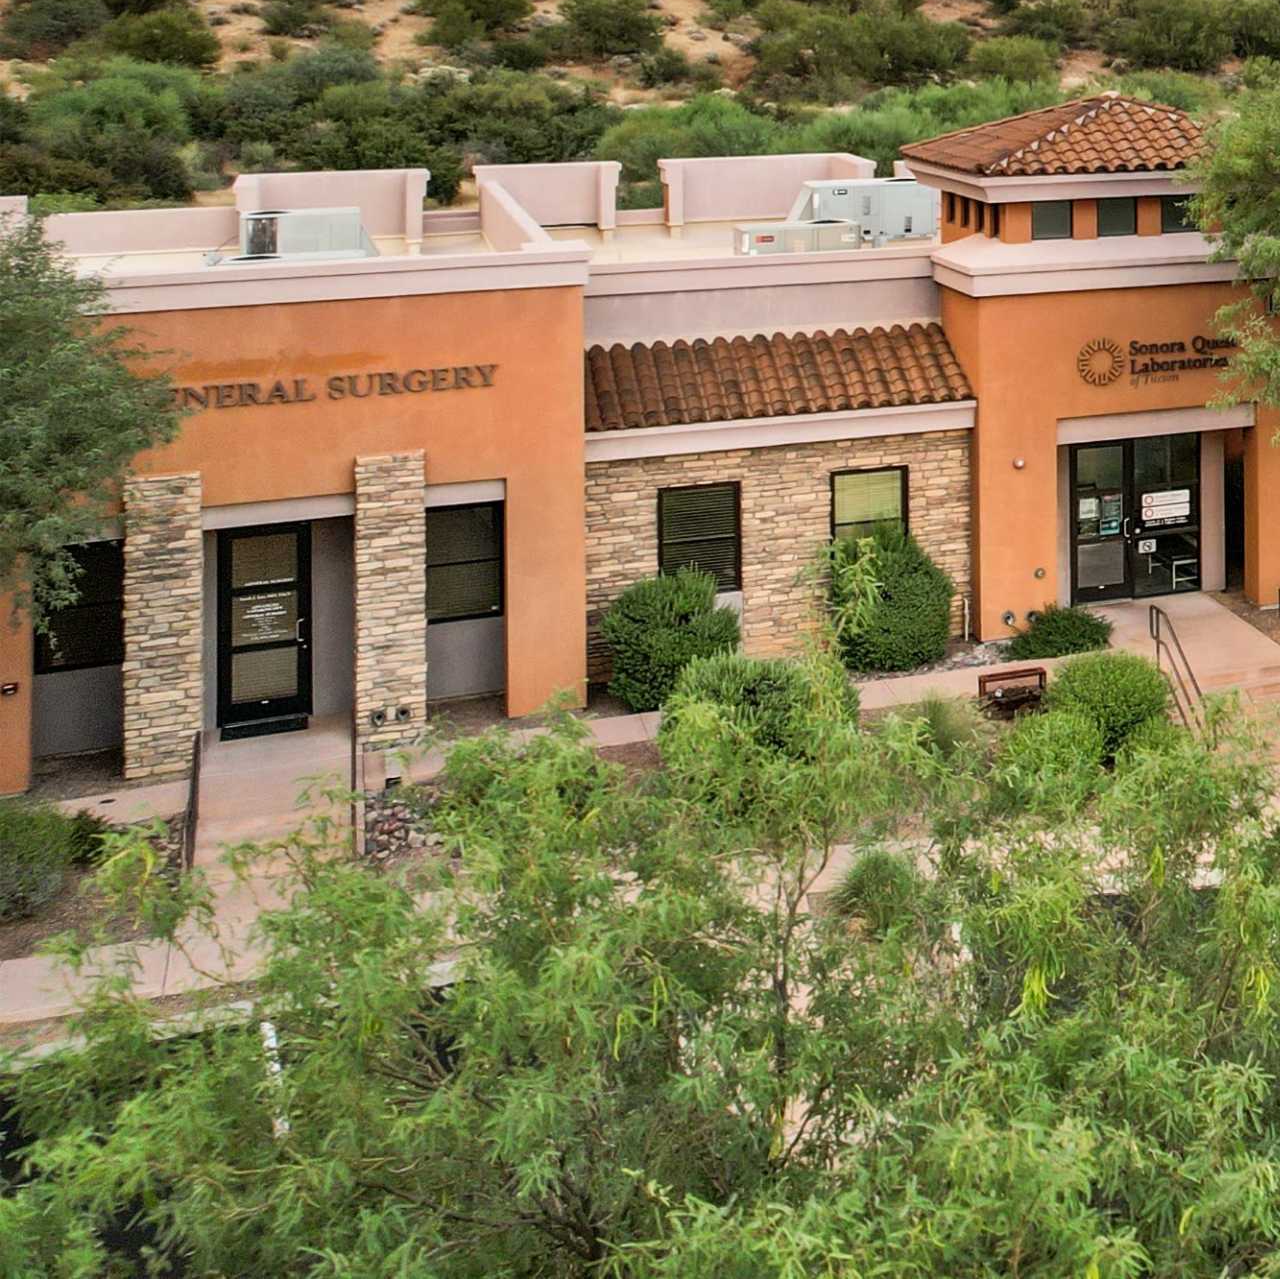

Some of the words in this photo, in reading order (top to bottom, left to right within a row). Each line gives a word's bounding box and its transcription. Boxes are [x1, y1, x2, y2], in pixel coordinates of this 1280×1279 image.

[1129, 339, 1186, 356] Sonora
[160, 377, 317, 411] NERAL
[327, 364, 499, 401] SURGERY
